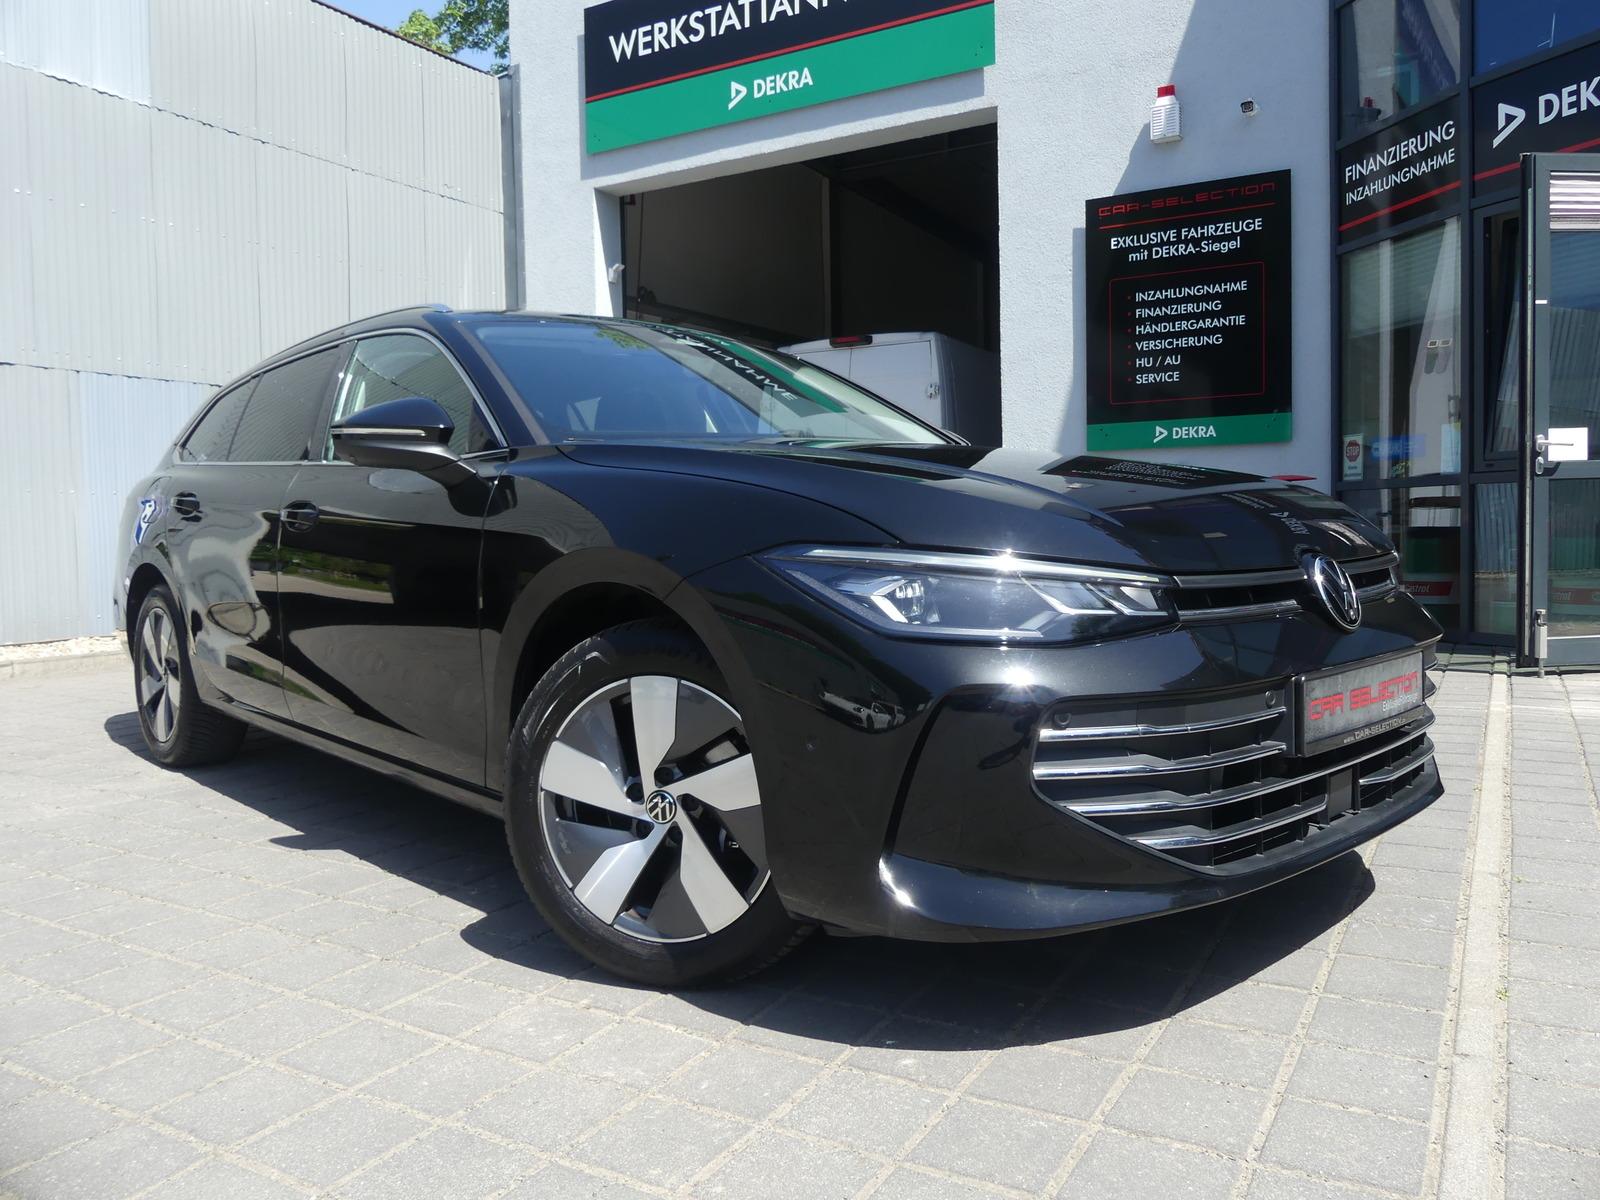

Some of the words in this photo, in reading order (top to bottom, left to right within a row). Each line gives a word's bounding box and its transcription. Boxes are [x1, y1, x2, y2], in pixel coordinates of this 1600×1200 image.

[608, 0, 848, 64] WERKSTATTA
[753, 67, 813, 99] DEKRA
[1345, 120, 1456, 184] FINANZIERUNG
[1345, 148, 1456, 206] INZAHLUNGNAHME
[1098, 182, 1276, 217] CAR-SELECTION
[1110, 229, 1177, 250] EXKLUSIVE
[1181, 218, 1263, 241] FAHRZEUGE
[1128, 249, 1149, 263] mit
[1152, 236, 1241, 260] DEKRA-Siegel
[1135, 280, 1248, 302] INZAHLUNGNAHME
[1135, 300, 1222, 319] FINANZIERUNG
[1135, 314, 1246, 335] HÄNDLERGARANTIE
[1135, 334, 1223, 351] VERSICHERUNG
[1135, 357, 1153, 368] HU
[1164, 354, 1181, 366] AU
[1135, 371, 1180, 385] SERVICE
[1172, 425, 1217, 440] DEKRA
[1310, 692, 1344, 721] CAR
[1350, 671, 1420, 710] SELECTION
